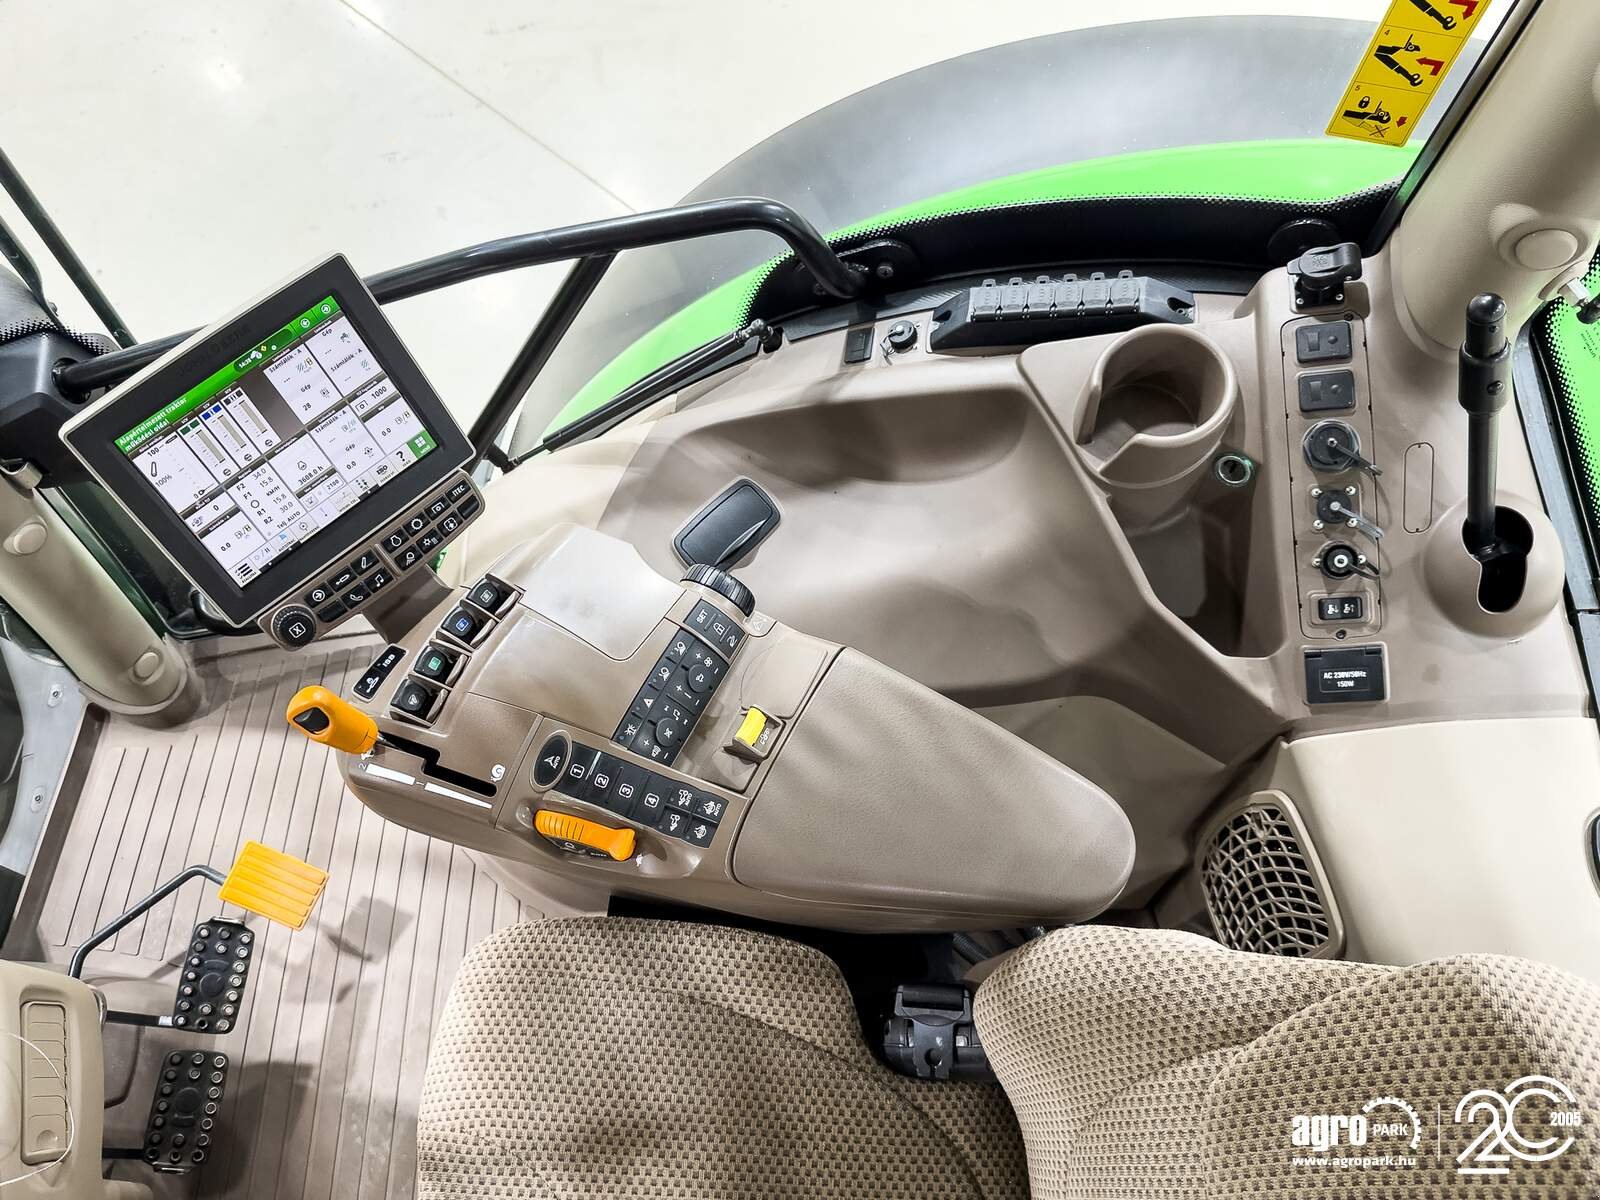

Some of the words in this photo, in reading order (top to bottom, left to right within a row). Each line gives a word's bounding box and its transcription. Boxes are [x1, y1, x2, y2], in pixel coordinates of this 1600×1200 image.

[370, 385, 387, 399] 1000
[301, 401, 312, 411] 28
[381, 427, 392, 436] 0.0
[146, 446, 160, 457] 100
[345, 460, 357, 470] 0.0
[154, 473, 173, 488] 100%
[235, 482, 246, 491] F2
[251, 467, 267, 480] 34.0
[297, 468, 318, 485] 3608.0
[242, 491, 252, 499] F1
[258, 475, 273, 488] 15.8
[256, 507, 266, 516] R1
[272, 492, 287, 504] 15.8
[263, 515, 273, 524] R2
[278, 500, 294, 513] 30.0
[286, 510, 301, 522] AUTO
[219, 541, 232, 552] 0.0
[696, 608, 708, 624] SET
[382, 654, 396, 668] ISO
